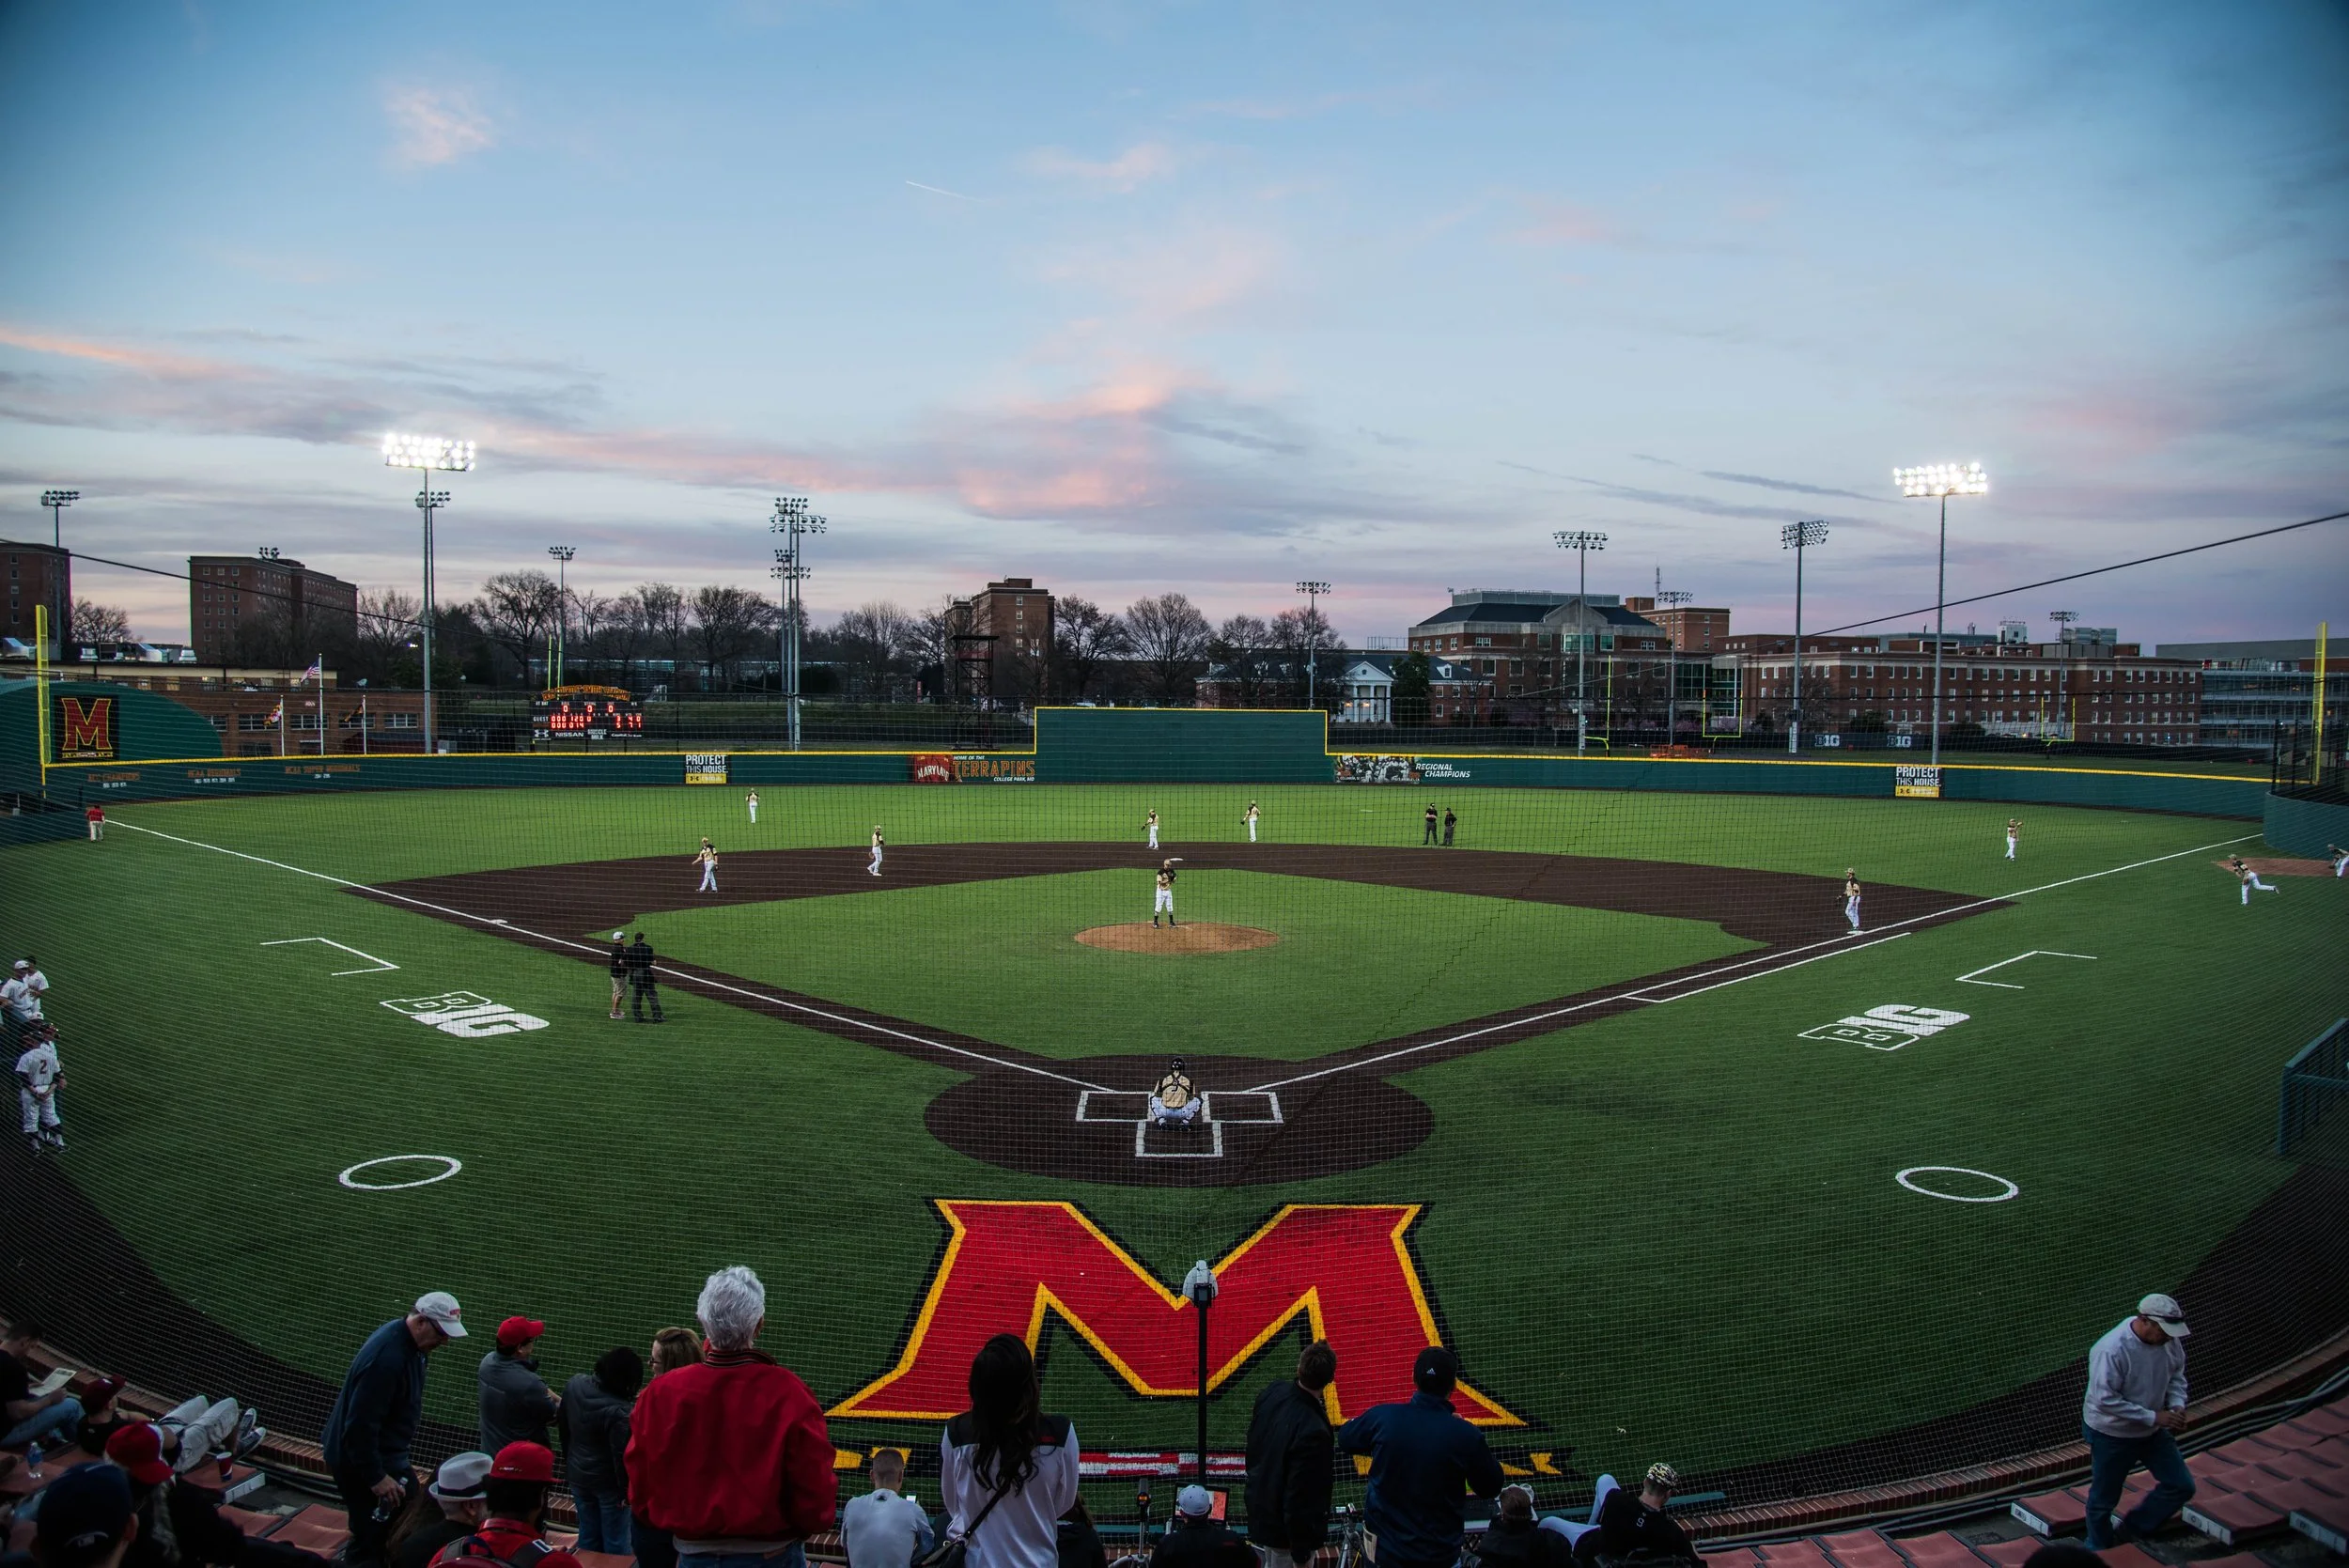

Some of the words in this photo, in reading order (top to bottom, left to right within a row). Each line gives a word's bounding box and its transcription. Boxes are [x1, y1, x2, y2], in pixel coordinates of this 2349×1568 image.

[60, 697, 113, 751] M
[685, 754, 727, 766] PROTECT
[685, 765, 702, 773] THIS
[917, 765, 950, 782] MARYLAND
[952, 760, 1035, 778] TERRAPINS
[1895, 766, 1939, 778] PROTECT
[1895, 778, 1913, 786] THIS
[39, 1059, 48, 1075] 2
[824, 1198, 1532, 1427] M
